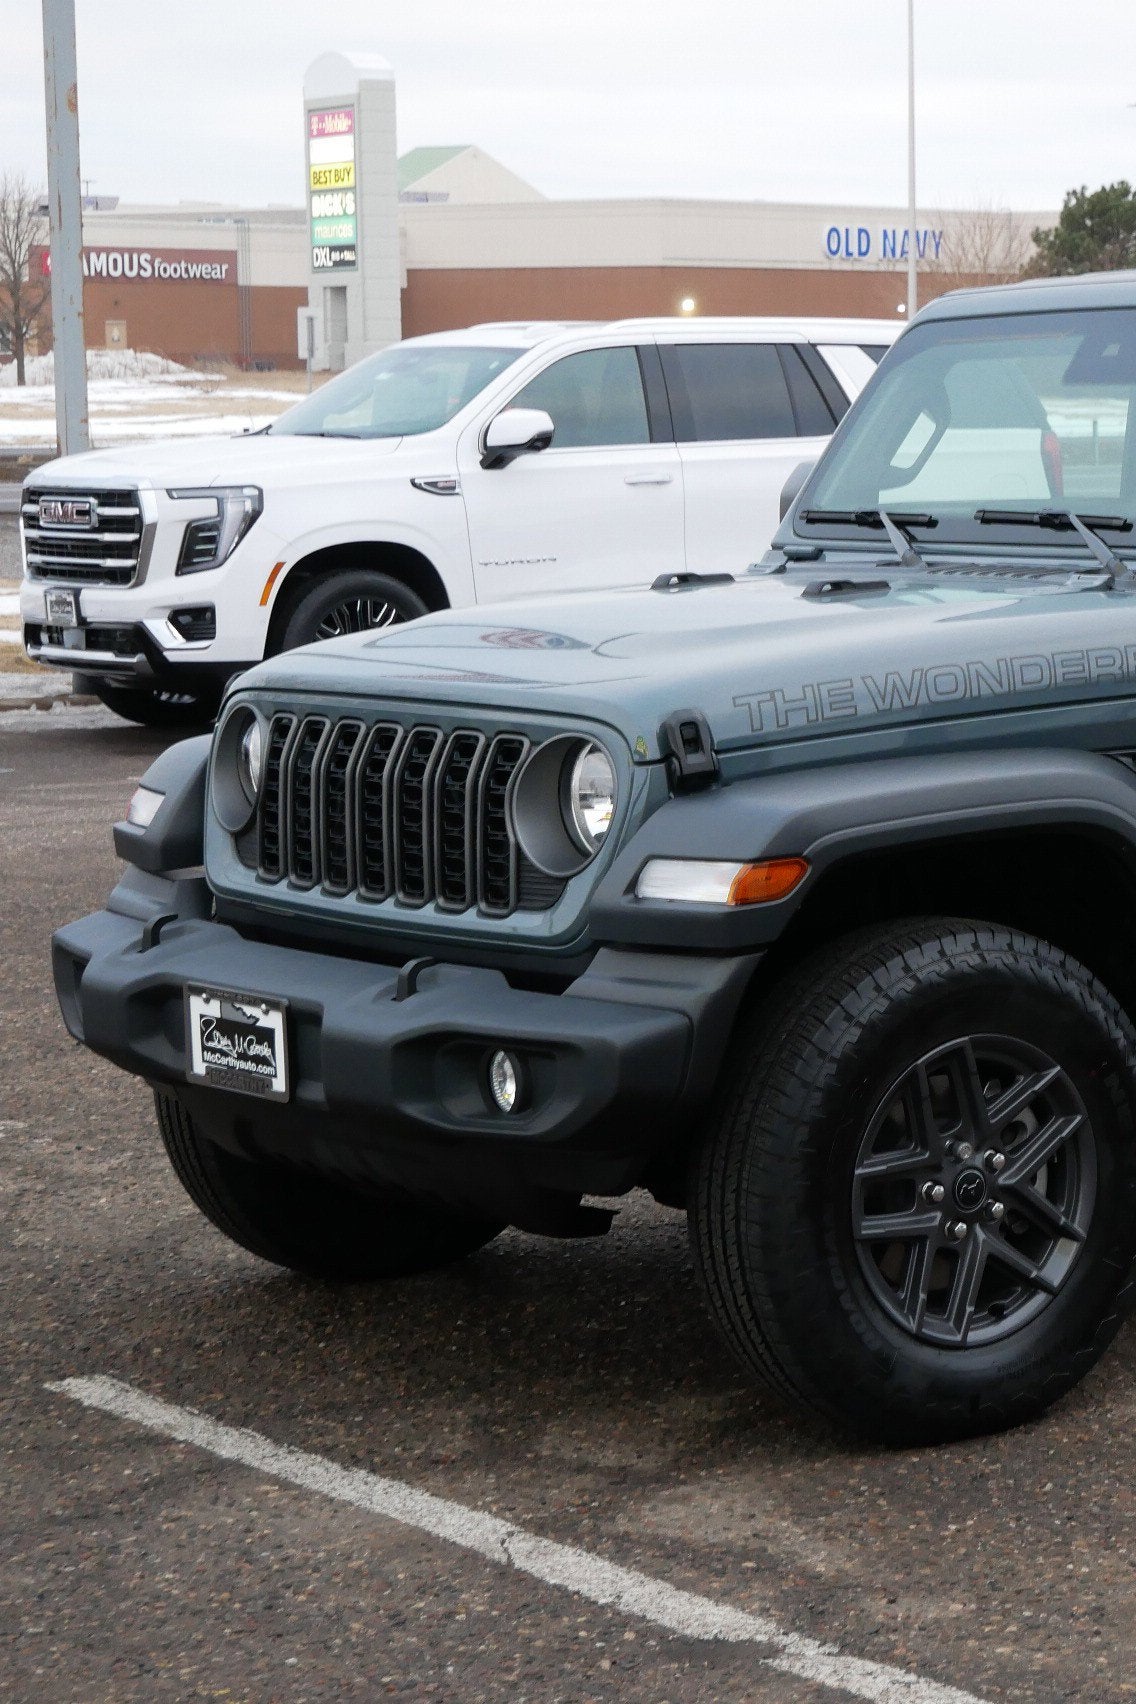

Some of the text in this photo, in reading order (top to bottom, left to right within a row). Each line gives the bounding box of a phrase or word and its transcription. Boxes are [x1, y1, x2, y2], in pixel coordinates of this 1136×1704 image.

[312, 167, 353, 185] BEST BUY
[826, 227, 943, 259] OLD NAVY
[313, 246, 333, 267] DXL
[154, 258, 229, 280] footwear
[40, 501, 91, 524] GMC
[731, 678, 858, 732] THE
